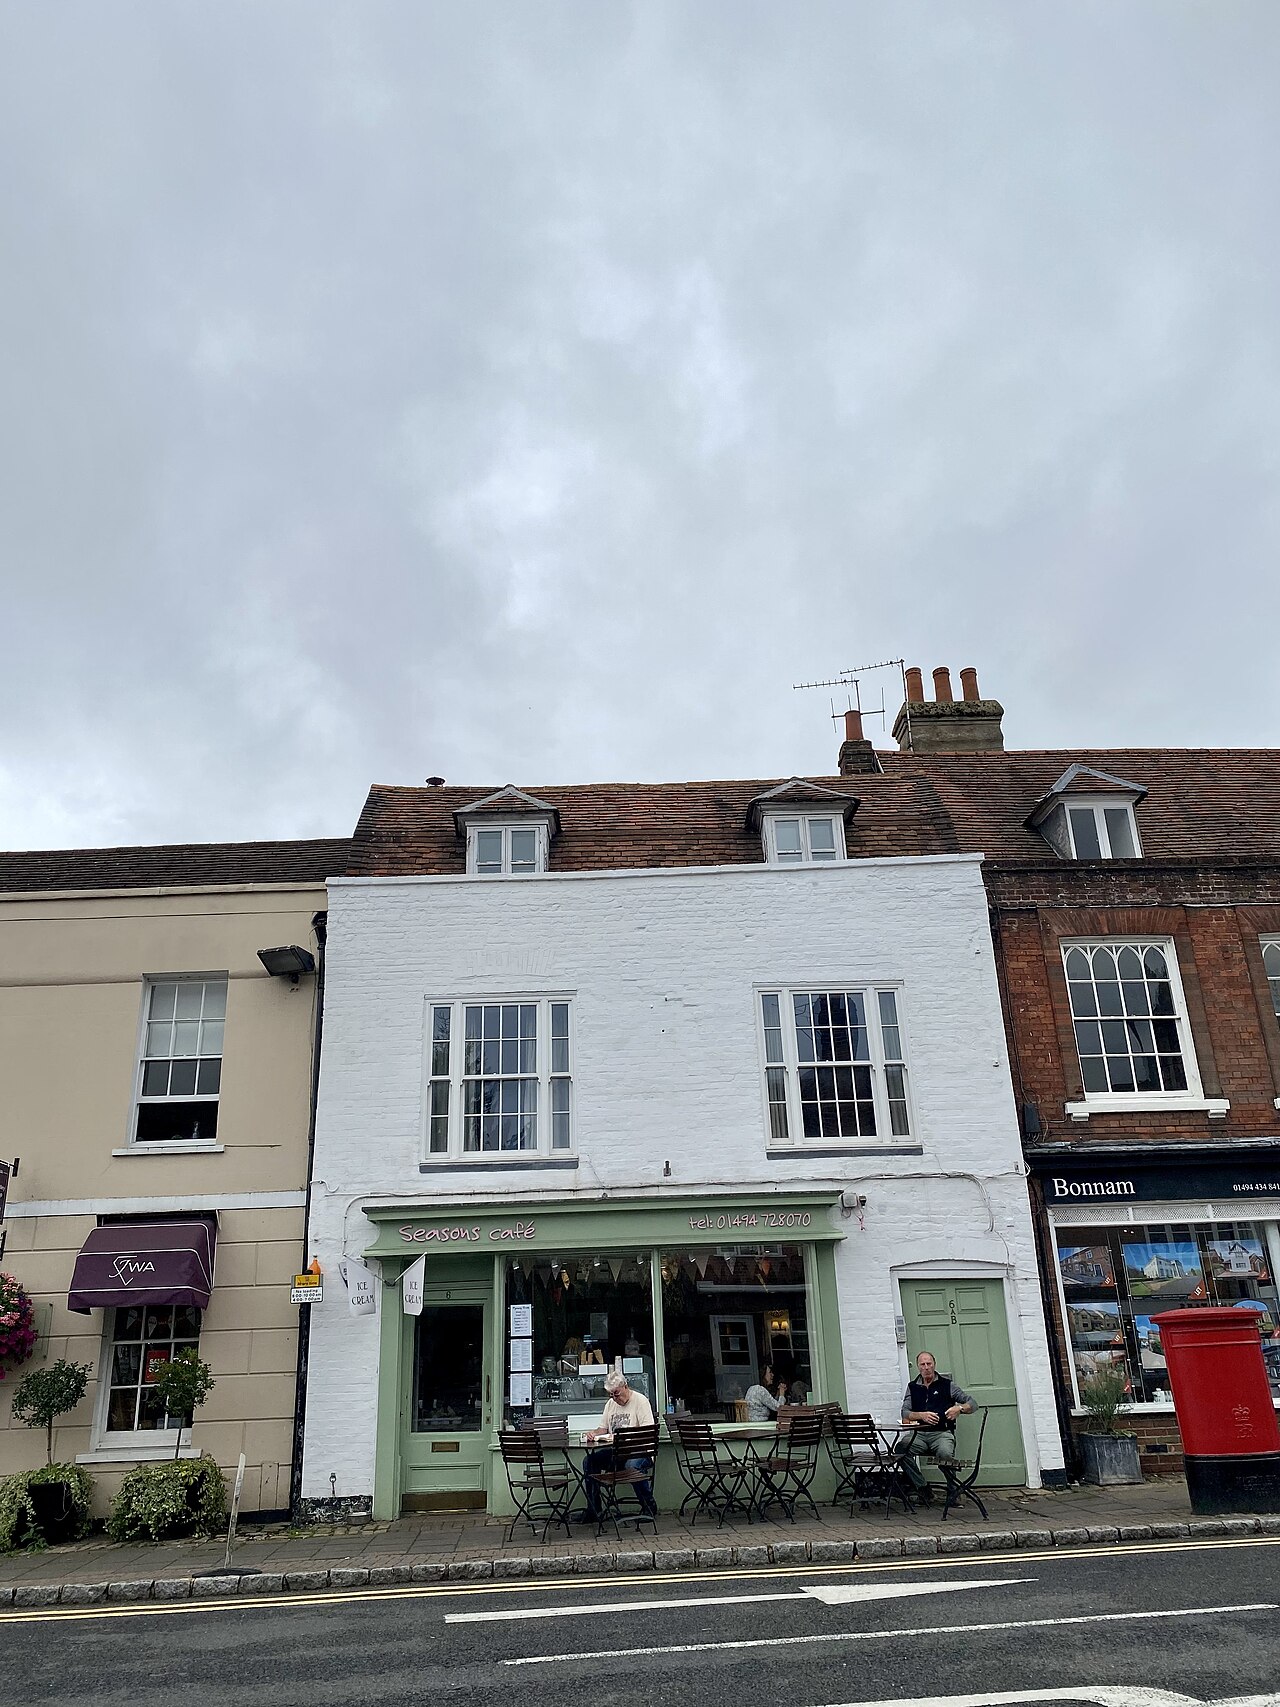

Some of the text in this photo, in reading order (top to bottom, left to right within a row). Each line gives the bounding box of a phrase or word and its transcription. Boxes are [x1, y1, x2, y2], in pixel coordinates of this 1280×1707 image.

[1052, 1178, 1136, 1197] Bonnam
[1233, 1183, 1254, 1191] 01494
[690, 1212, 811, 1229] tel: 01494 728070
[398, 1221, 535, 1241] Seasons café
[357, 1281, 368, 1291] ICE
[409, 1281, 418, 1290] ICE
[1194, 1286, 1203, 1296] LET
[351, 1294, 375, 1306] CREAM
[949, 1300, 955, 1308] 6
[951, 1316, 957, 1325] B
